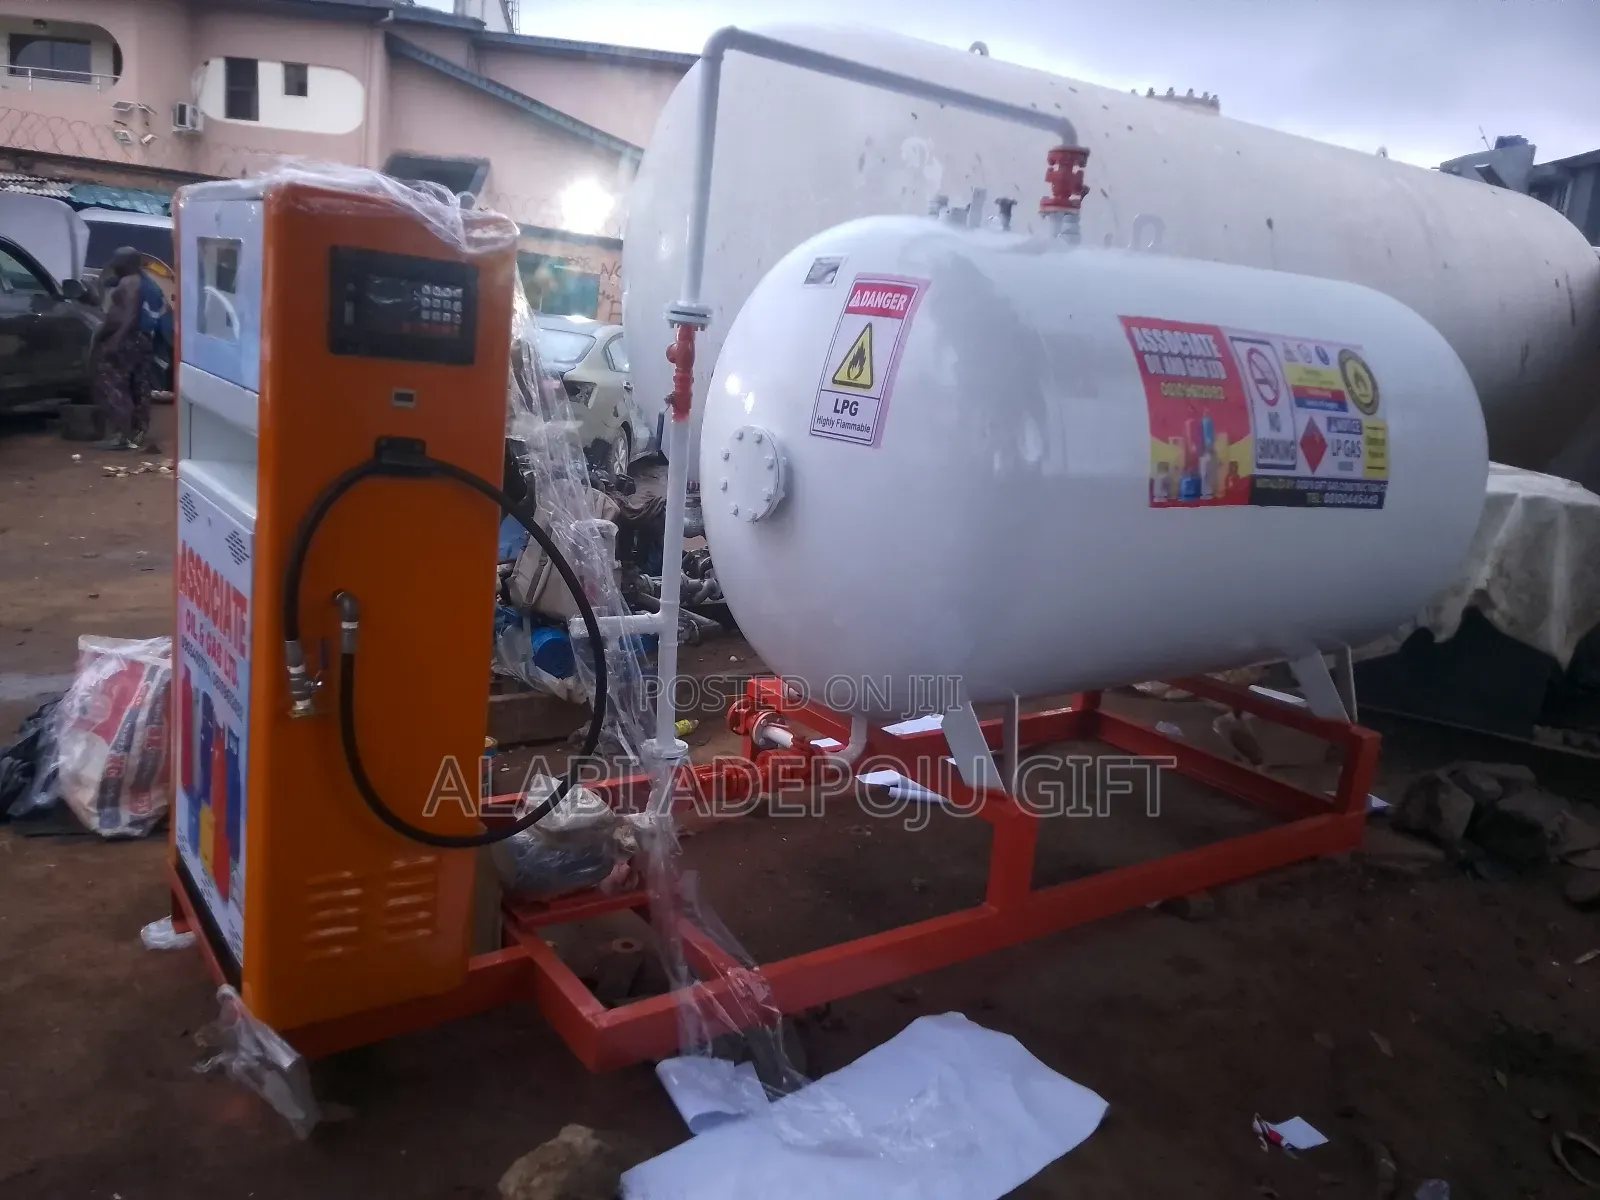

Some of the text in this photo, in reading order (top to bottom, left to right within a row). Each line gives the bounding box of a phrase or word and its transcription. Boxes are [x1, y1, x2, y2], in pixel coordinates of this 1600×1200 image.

[861, 290, 908, 311] DANGER
[1130, 326, 1223, 358] ASSOCIATE
[1185, 357, 1209, 378] GAS
[833, 398, 859, 416] LPG
[816, 414, 871, 433] Highly Flammable
[1267, 411, 1281, 433] NO
[1256, 438, 1297, 461] SMOKING
[1344, 440, 1362, 458] GAS
[177, 539, 248, 660] ASSOCIATE
[185, 608, 198, 641] OIL
[206, 631, 223, 669] GAS
